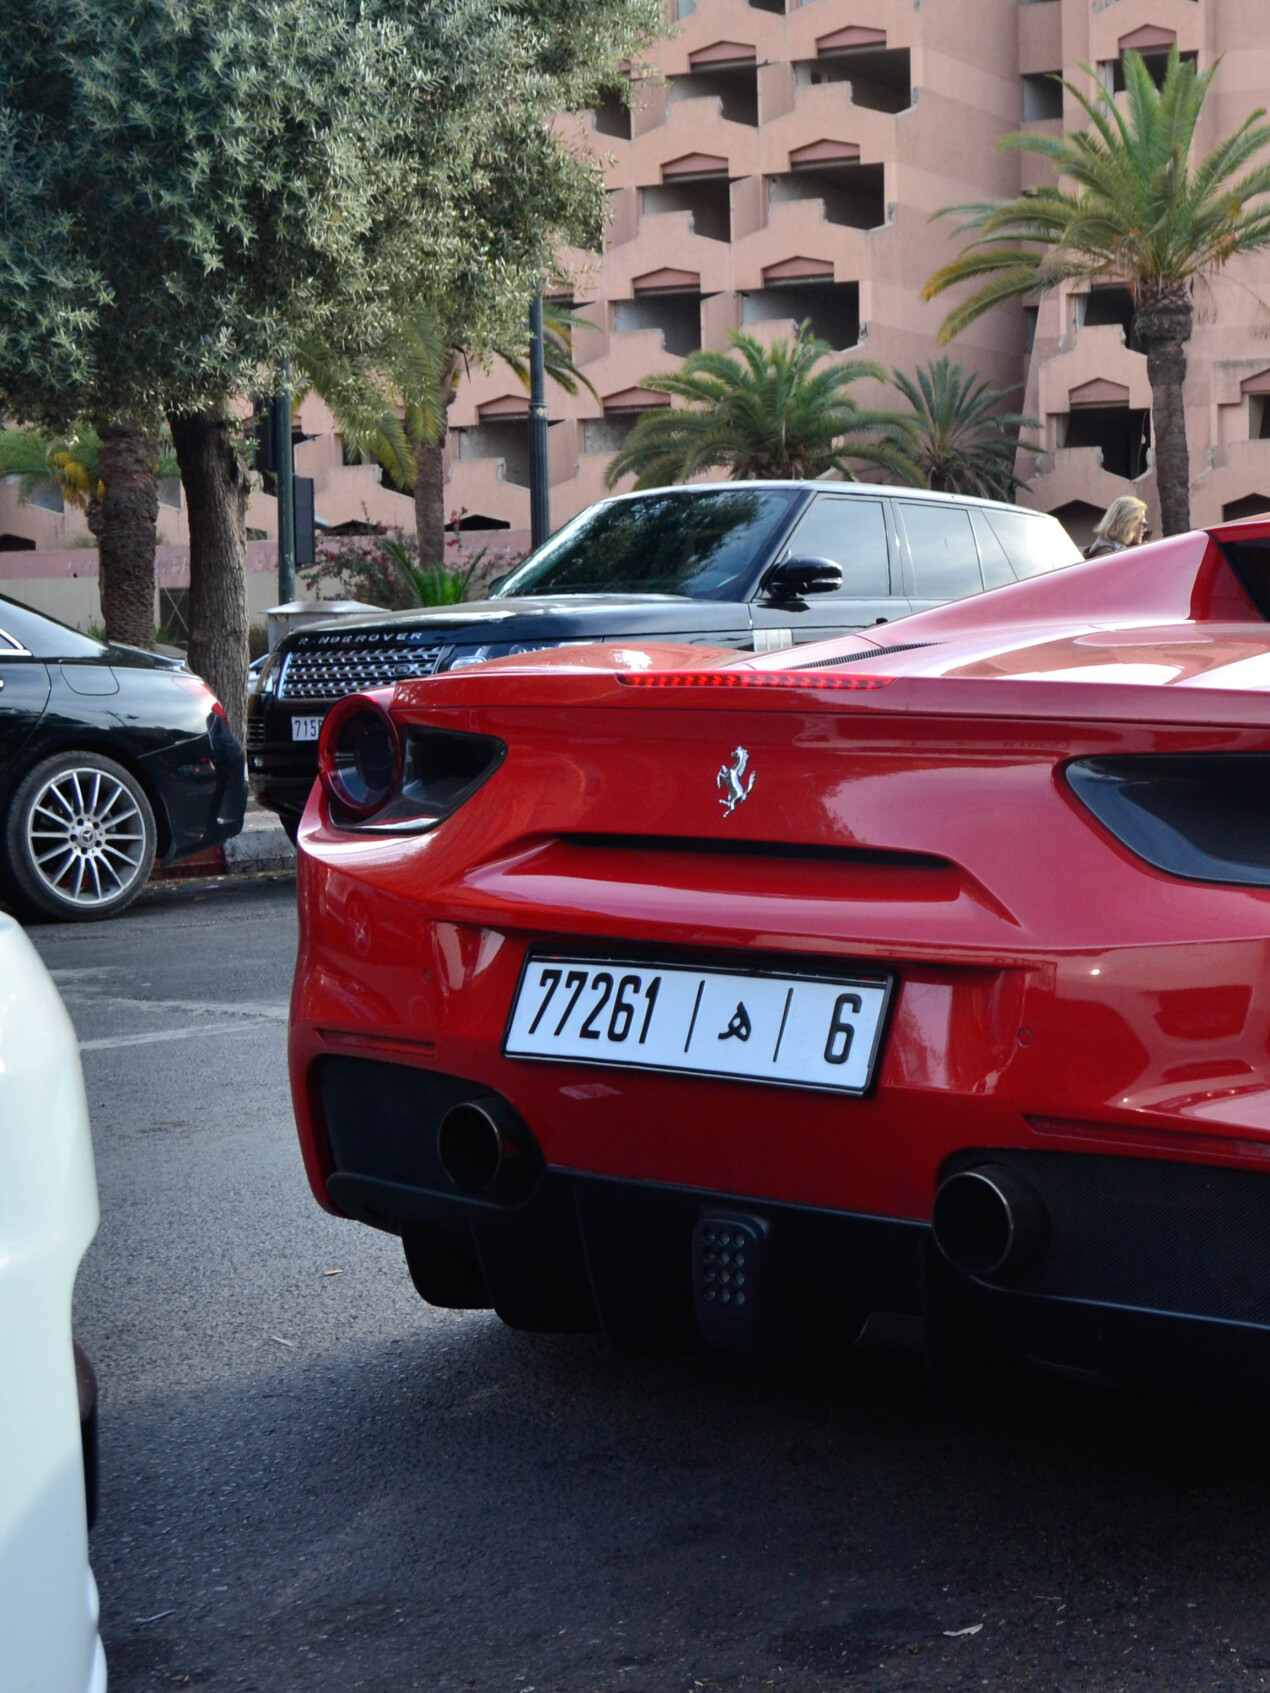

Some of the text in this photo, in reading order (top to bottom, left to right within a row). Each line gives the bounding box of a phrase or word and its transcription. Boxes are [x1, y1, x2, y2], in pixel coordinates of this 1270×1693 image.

[298, 635, 353, 645] RNGE
[528, 969, 662, 1044] 77261
[824, 993, 863, 1064] 6
